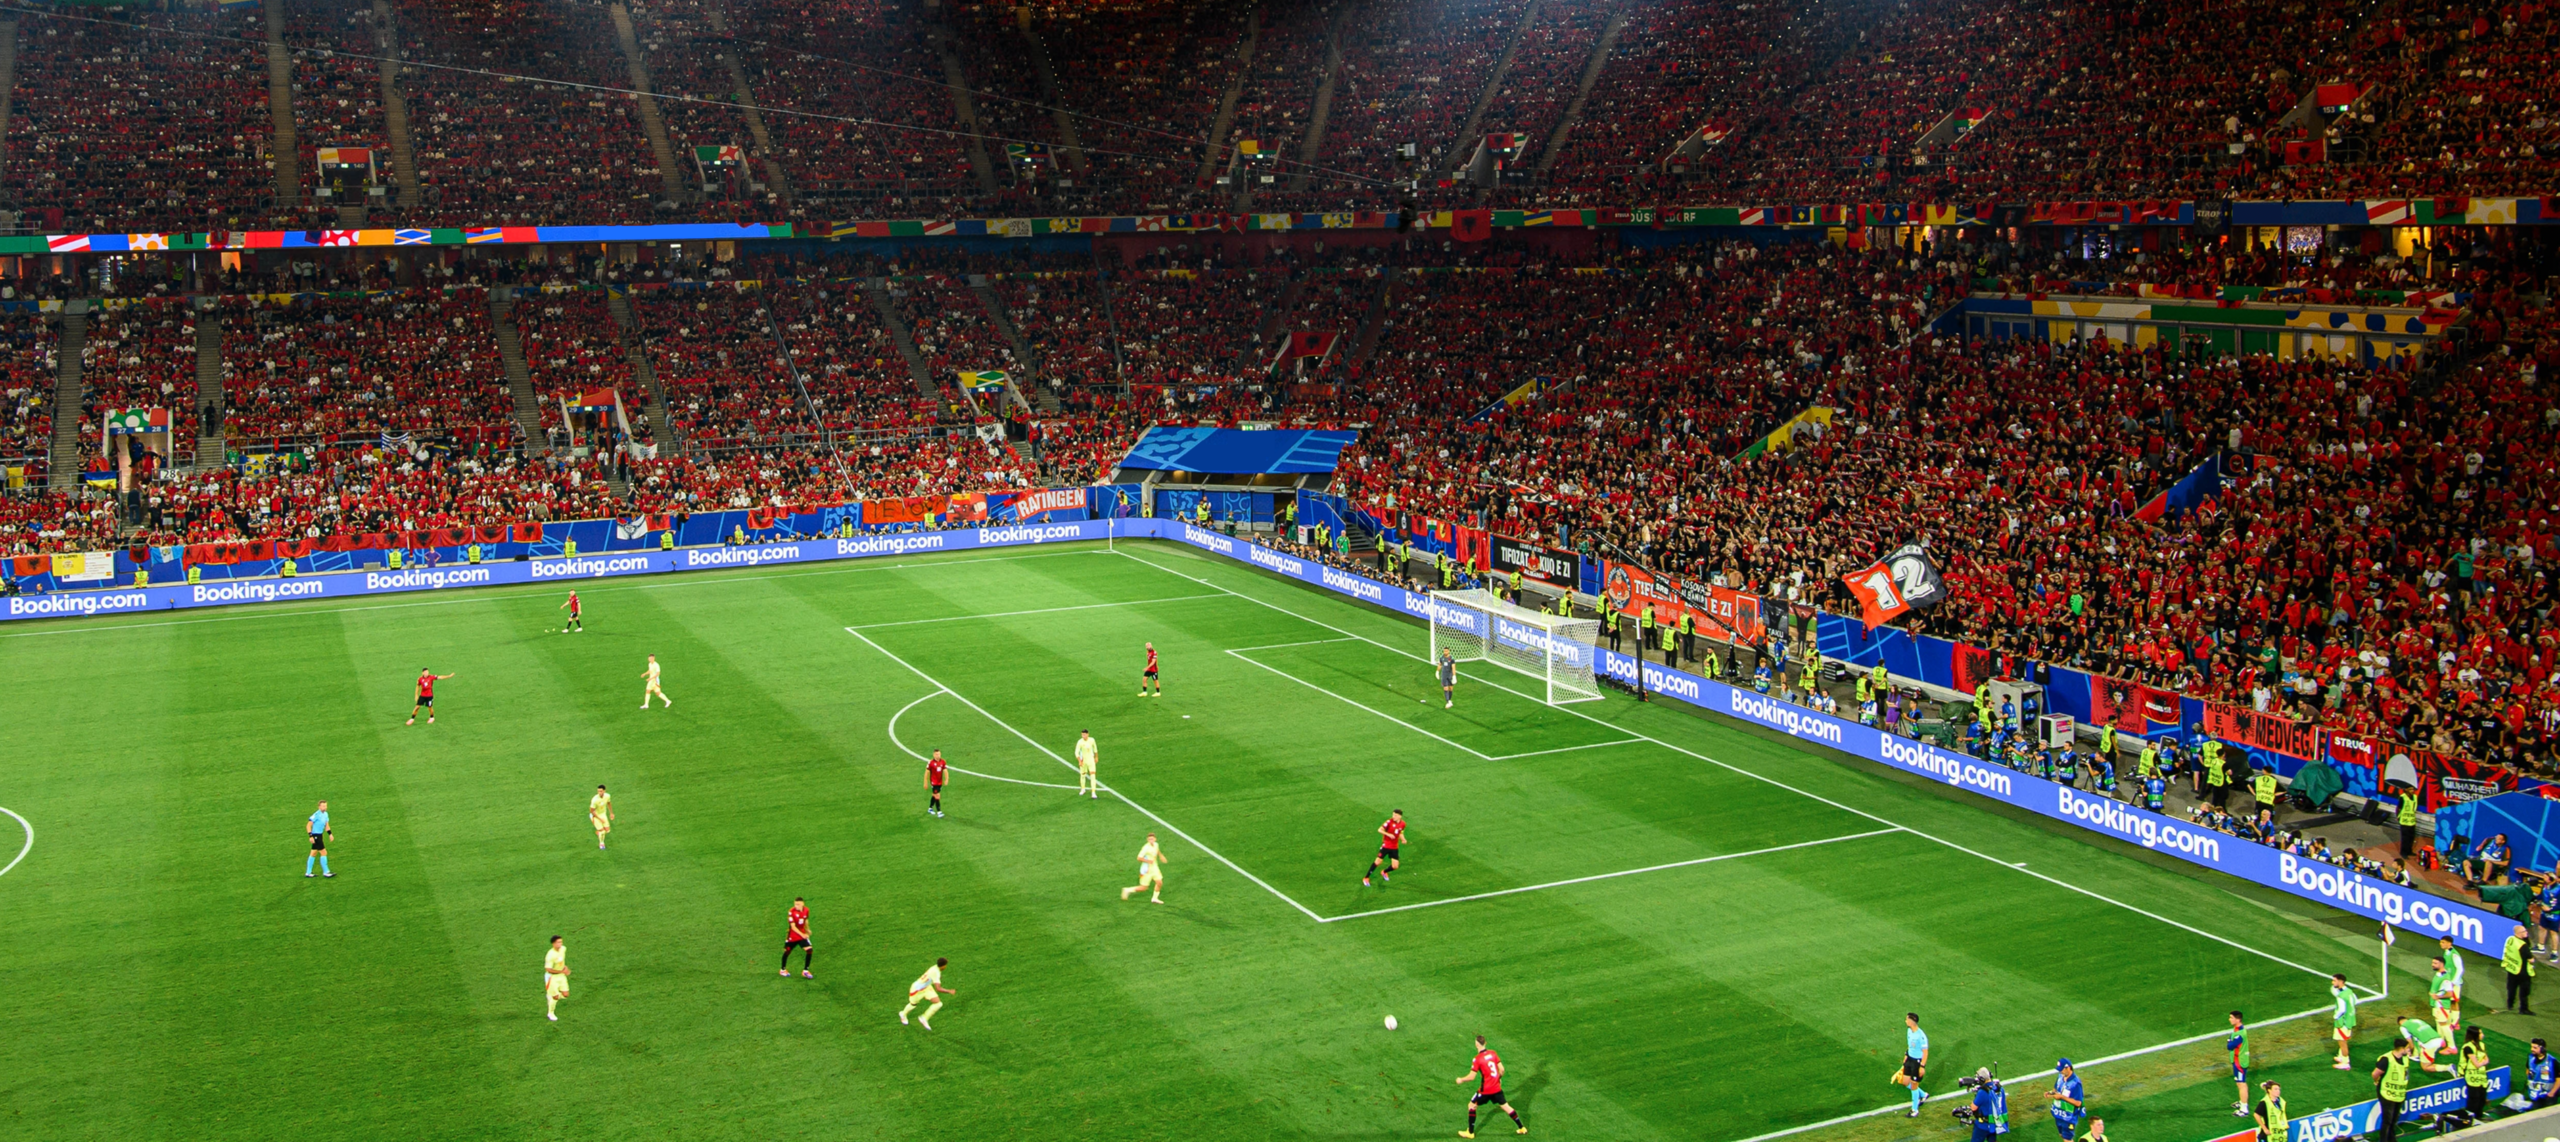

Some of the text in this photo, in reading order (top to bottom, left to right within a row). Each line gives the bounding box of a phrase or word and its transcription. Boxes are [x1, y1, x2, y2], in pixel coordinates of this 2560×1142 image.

[164, 470, 176, 479] 28
[1017, 489, 1084, 517] RATINGEN
[836, 533, 943, 555] Booking.com
[979, 523, 1080, 544] Booking.com
[1185, 524, 1233, 553] Booking.com
[531, 556, 648, 577] Booking.com
[688, 546, 800, 566] Booking.com
[1250, 545, 1302, 575] Booking.com
[1501, 546, 1529, 567] TIFOZAT
[1540, 556, 1555, 576] KUQ
[1556, 560, 1562, 576] E
[1563, 561, 1571, 578] ZI
[366, 566, 490, 590] Booking.com
[1322, 566, 1382, 600] Booking.com
[1681, 578, 1705, 594] KOSOVA
[1861, 555, 1936, 611] 12
[193, 579, 323, 602] Booking.com
[10, 593, 147, 614] Booking.com
[1405, 592, 1474, 629] Bookng.com
[1711, 598, 1718, 614] E
[1720, 601, 1732, 618] ZI
[1500, 620, 1579, 662] Bookingcom
[1767, 628, 1784, 638] TAKU
[1731, 688, 1842, 743] Booking.com
[2206, 703, 2231, 716] KUQ
[2215, 715, 2223, 725] E
[2213, 726, 2224, 737] ZI
[2334, 736, 2372, 754] STRUGA
[1881, 732, 2011, 796] Booking.com
[2059, 785, 2219, 862] Booking.com
[2280, 852, 2483, 945] Booking.com
[1487, 1060, 1498, 1078] 3
